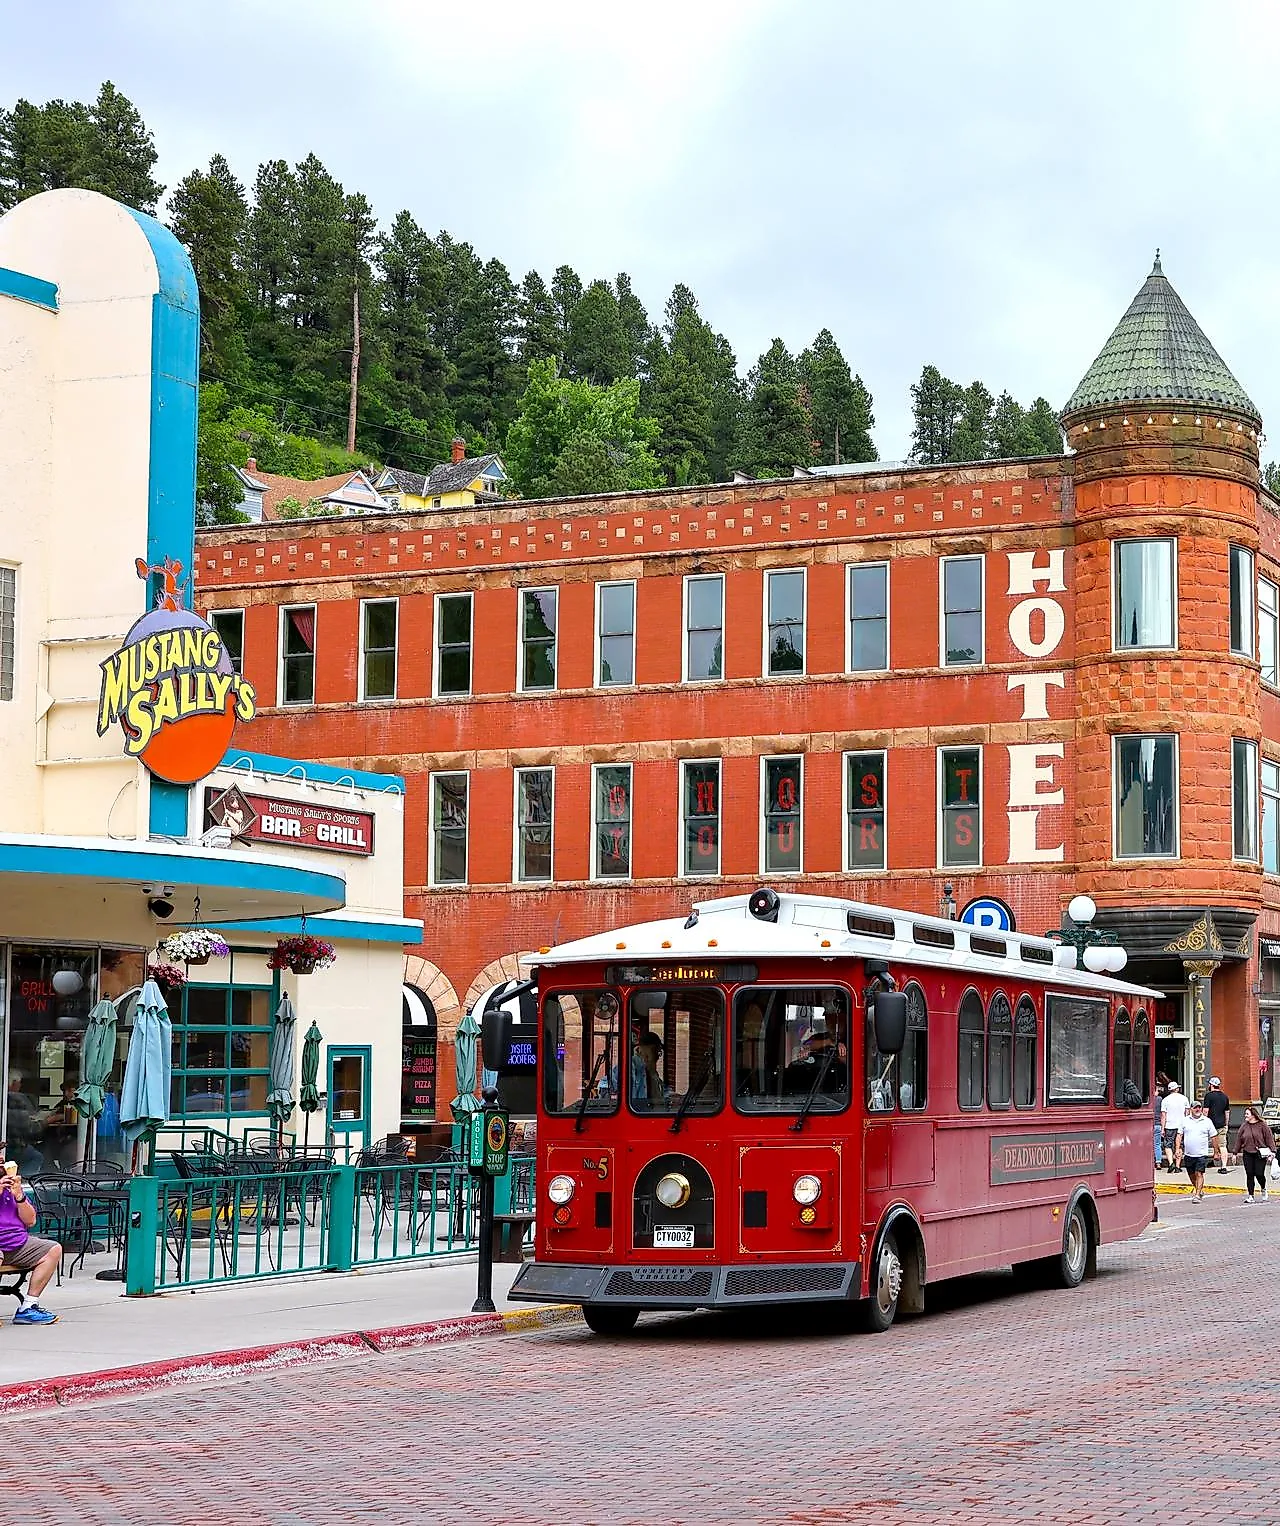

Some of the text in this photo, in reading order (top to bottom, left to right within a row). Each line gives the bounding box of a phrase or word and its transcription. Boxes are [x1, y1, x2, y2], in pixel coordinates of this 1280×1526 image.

[98, 629, 222, 737] MUSTANG
[125, 673, 256, 755] SALLY'S
[1005, 549, 1068, 863] HOTEL
[268, 803, 360, 825] MUSTANG SALLY'S SPORTS
[261, 815, 367, 847] BAR AND GRILL
[22, 981, 57, 997] GRILL
[27, 998, 48, 1012] ON
[413, 1043, 435, 1055] FREE
[414, 1080, 432, 1089] PIZZA
[415, 1095, 430, 1104] BEER
[487, 1153, 504, 1164] STOP
[1004, 1143, 1095, 1168] DEADWOOD TROLLEY
[583, 1157, 608, 1179] No. 5
[656, 1231, 692, 1242] CTY0032
